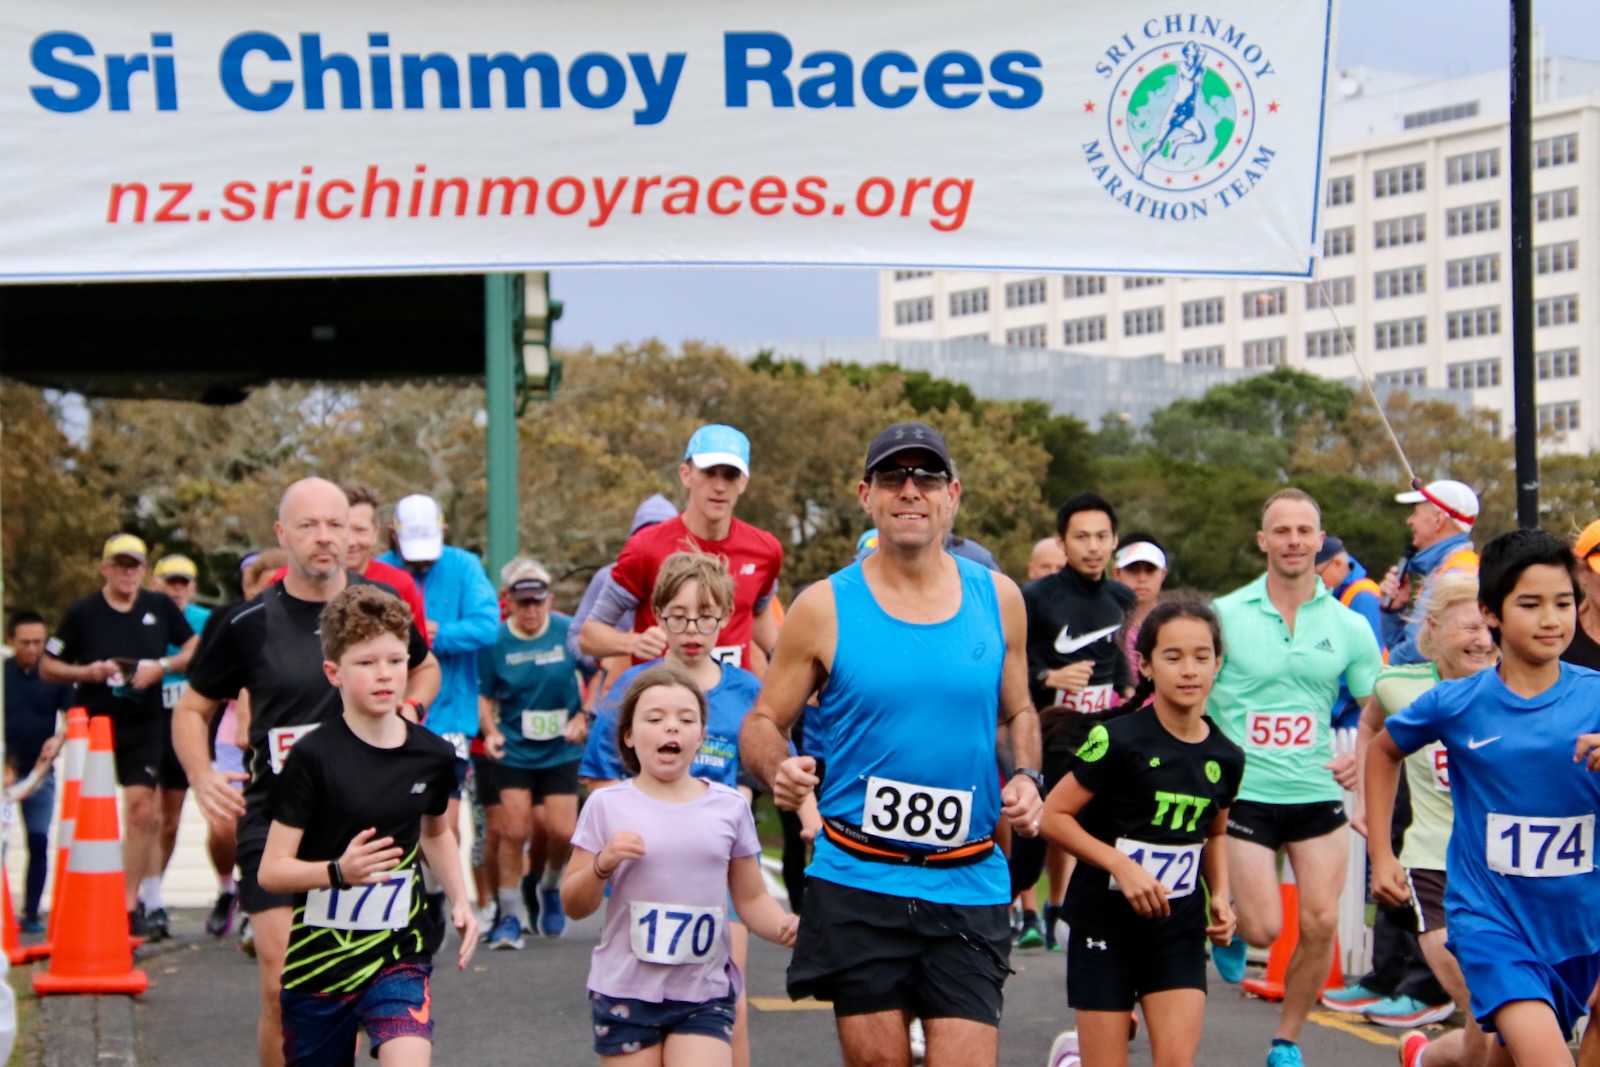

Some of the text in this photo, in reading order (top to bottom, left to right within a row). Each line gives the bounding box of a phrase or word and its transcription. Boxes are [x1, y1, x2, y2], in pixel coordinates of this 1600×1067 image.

[1095, 13, 1275, 79] SRI CHINMOY
[30, 31, 1044, 126] Sri Chinmoy Races
[106, 163, 975, 233] nz.srichinmoyraces.org
[1082, 139, 1277, 221] MARATHON TEAM
[1062, 688, 1107, 710] 554
[531, 715, 560, 736] 98
[1252, 715, 1312, 746] 552
[872, 786, 963, 842] 389
[1152, 790, 1211, 833] TTT
[1501, 822, 1585, 870] 174
[319, 877, 406, 923] 177
[638, 909, 716, 958] 170
